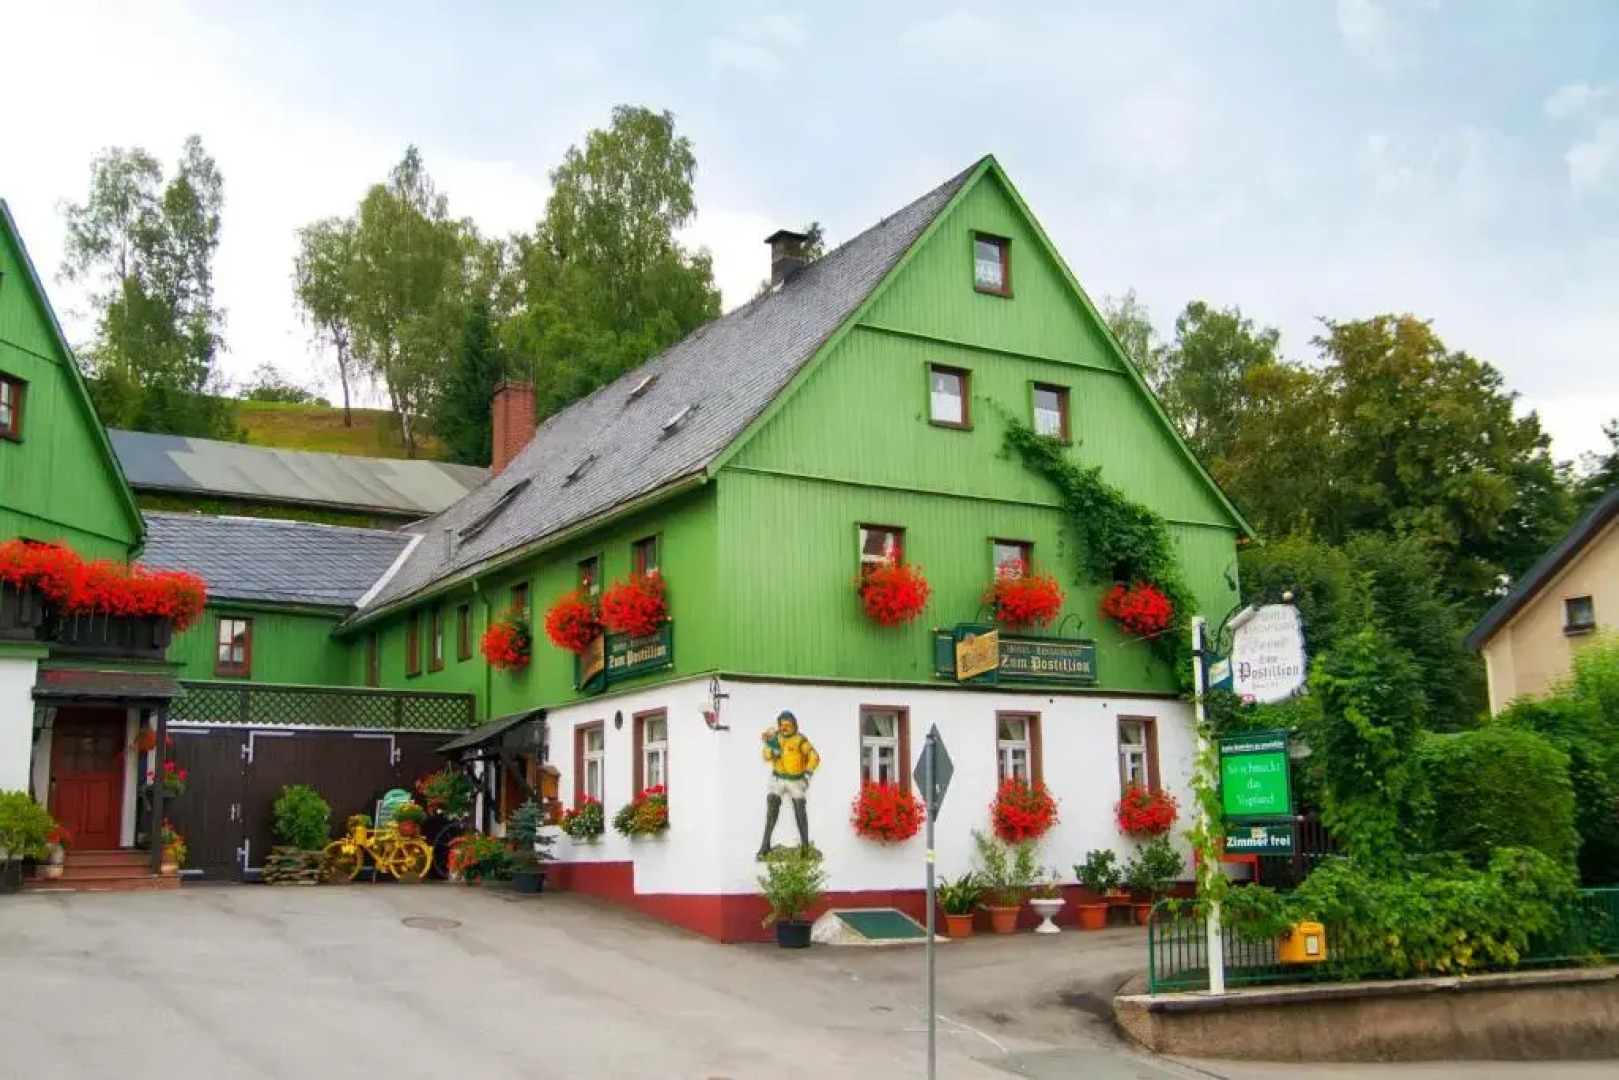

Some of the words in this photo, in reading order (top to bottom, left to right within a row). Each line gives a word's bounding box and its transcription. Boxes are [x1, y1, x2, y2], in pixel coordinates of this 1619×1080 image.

[1000, 654, 1027, 669] Zum
[1030, 656, 1091, 672] Postillion
[1239, 661, 1298, 682] Postillion
[1226, 836, 1268, 847] Zimmer
[1270, 834, 1291, 847] frei
